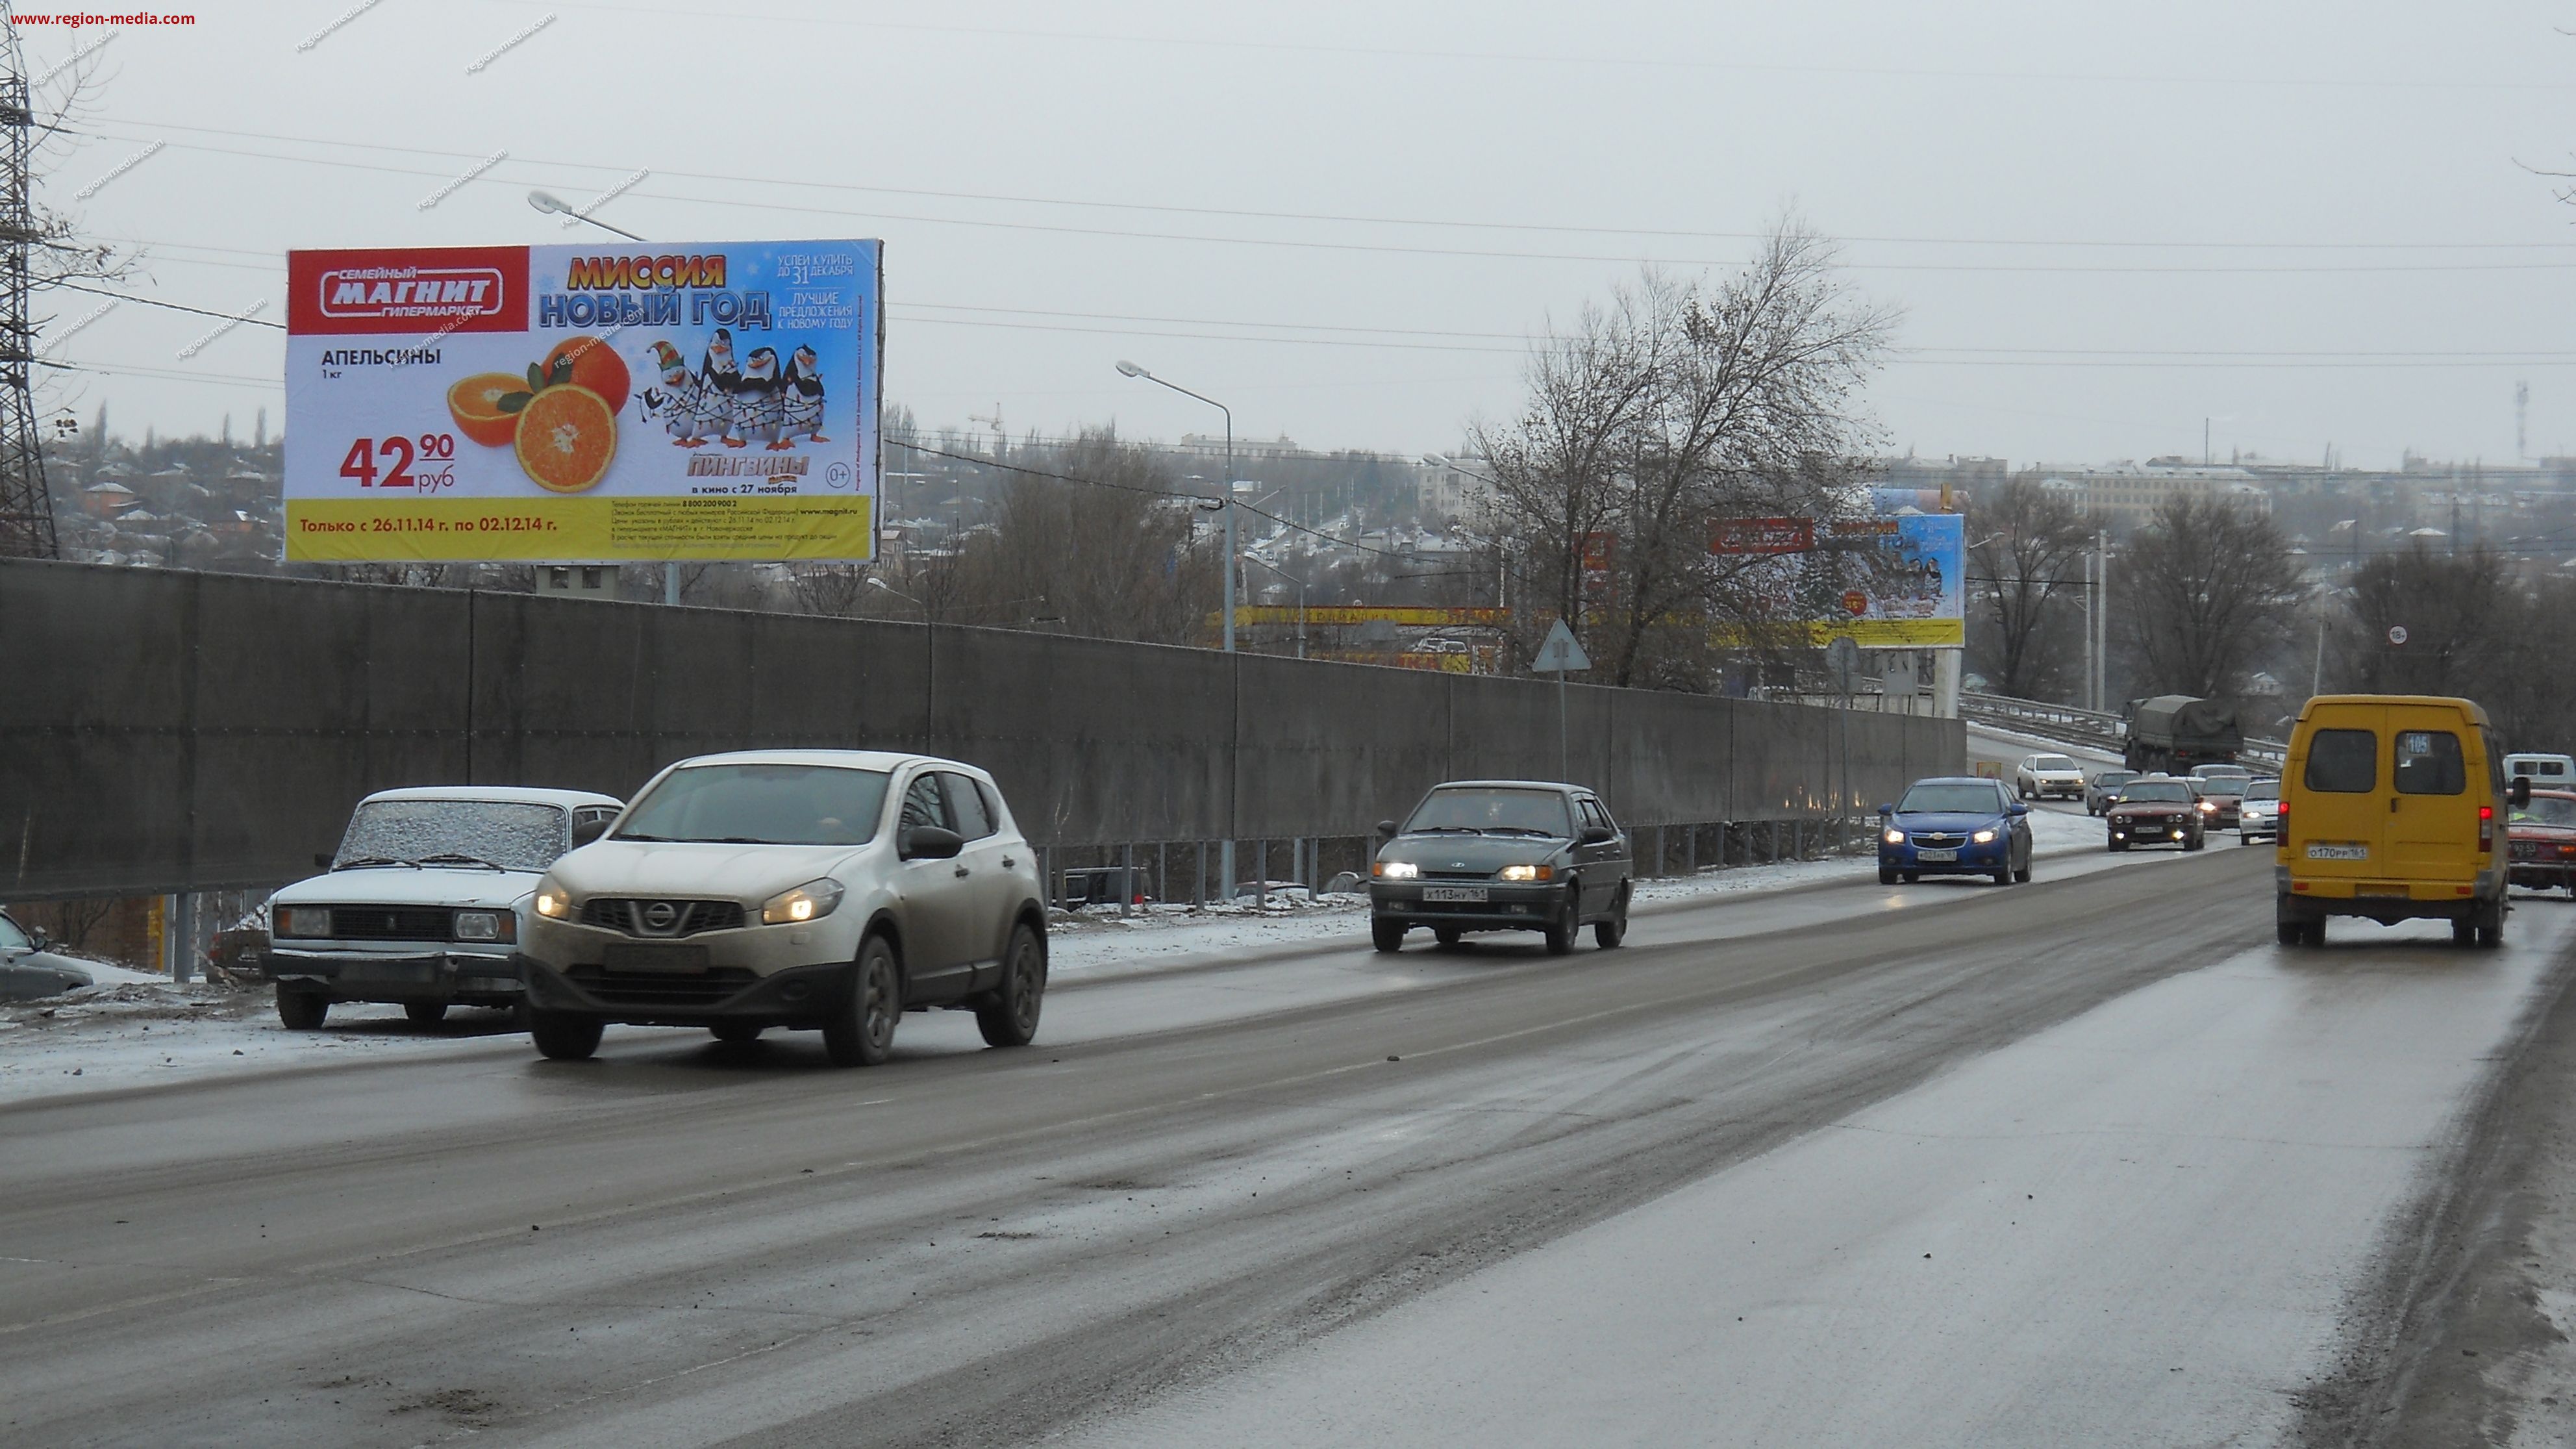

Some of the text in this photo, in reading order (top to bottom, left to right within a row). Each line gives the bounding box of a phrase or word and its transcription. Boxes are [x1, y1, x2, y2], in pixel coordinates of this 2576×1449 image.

[778, 253, 853, 266] УСПЕЙ КУПИТЬ
[338, 266, 418, 280] СЕМЕЙНЫЙ
[567, 254, 727, 290] МИССИЯ
[777, 266, 854, 284] ДО 31 ДЕКАБРЯ
[332, 279, 491, 305] МАГНИТ
[792, 292, 840, 306] ЛУЧШИЕ
[381, 305, 483, 317] ГИПЕРМАРКЕТ
[540, 284, 772, 331] НОВЫЙ ГОД
[779, 306, 853, 318] ПРЕДЛОЖЕНИЯ
[777, 318, 853, 329] К НОВОМУ ГОДУ
[321, 349, 441, 366] АПЕЛЬСИНЫ
[322, 370, 327, 379] 1
[340, 434, 454, 488] 42 90
[687, 456, 810, 477] ПИНГВИНЫ
[418, 464, 454, 493] руб
[830, 468, 847, 481] 0+
[740, 485, 755, 494] 27
[757, 483, 797, 496] ноября
[799, 508, 858, 516] www.magnit.ru
[299, 518, 557, 533] Только с 26.11.14 г. по 02.12.14 г.
[2409, 735, 2427, 753] 105
